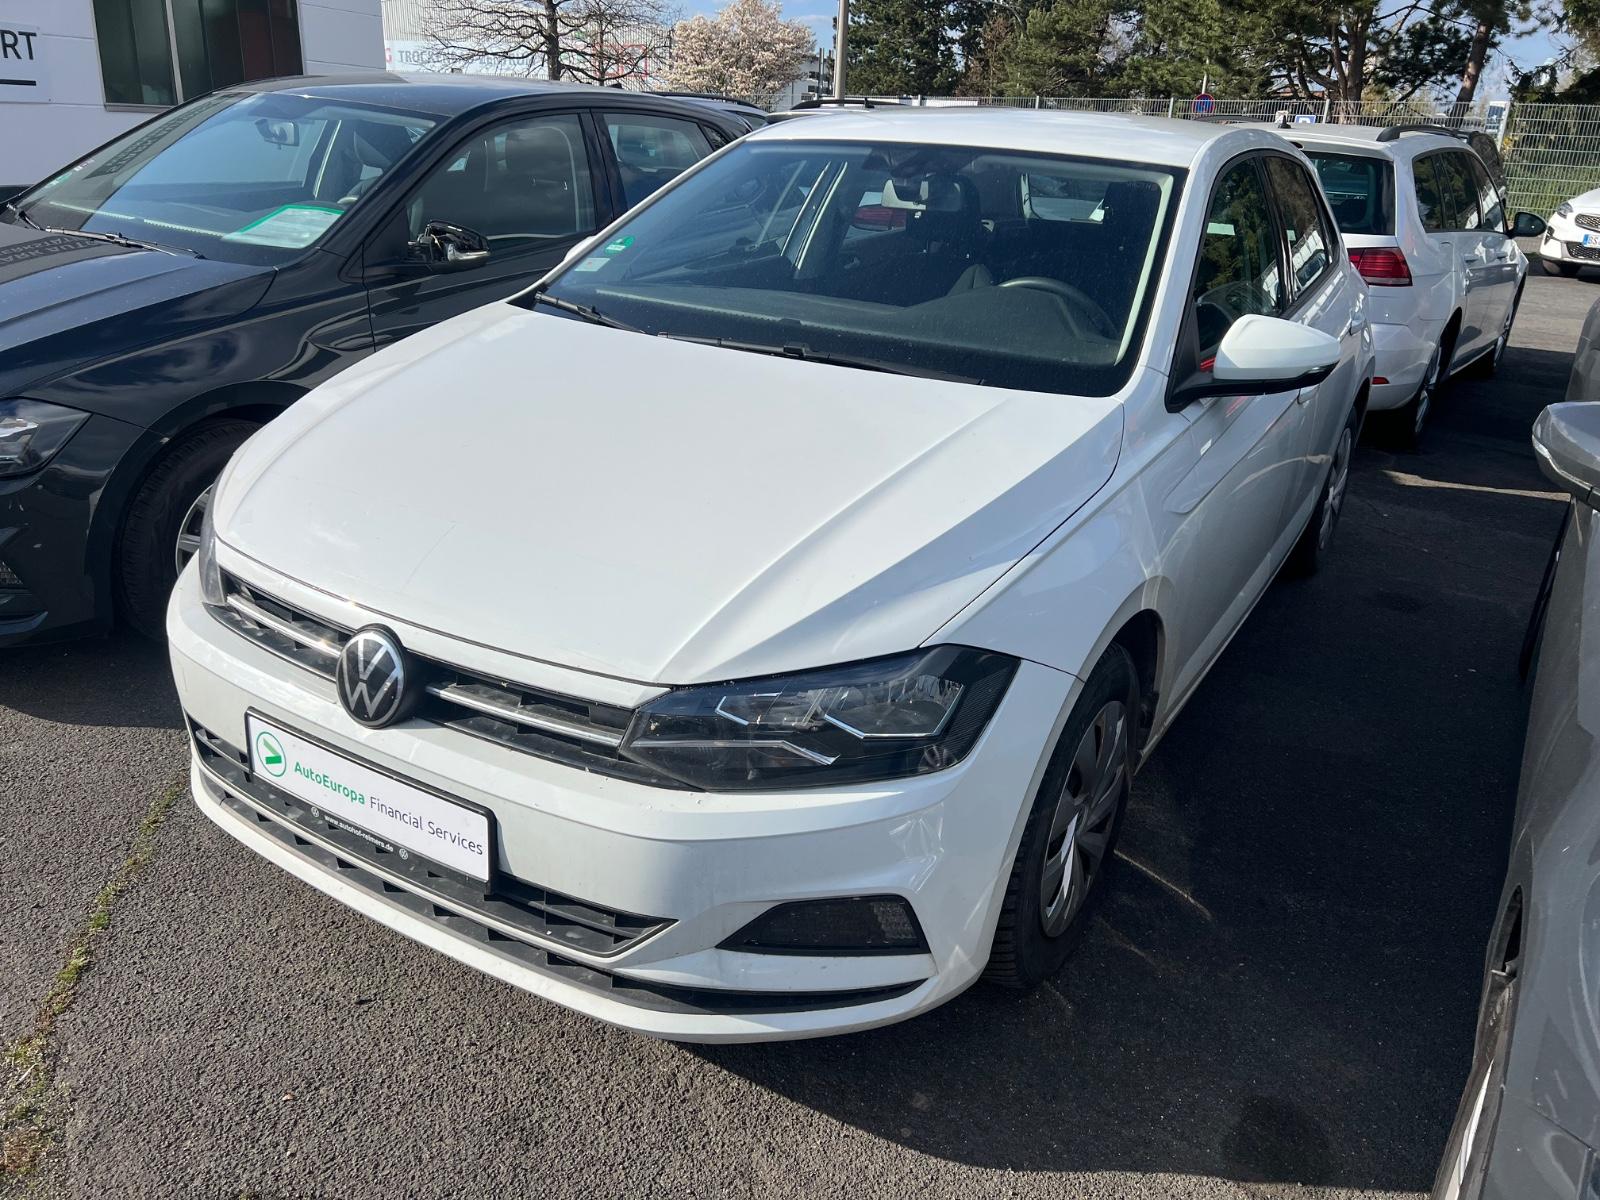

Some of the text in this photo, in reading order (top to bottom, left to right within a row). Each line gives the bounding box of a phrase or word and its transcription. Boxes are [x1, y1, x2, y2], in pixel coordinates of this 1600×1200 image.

[294, 761, 483, 856] AutoEuropa Financial Services
